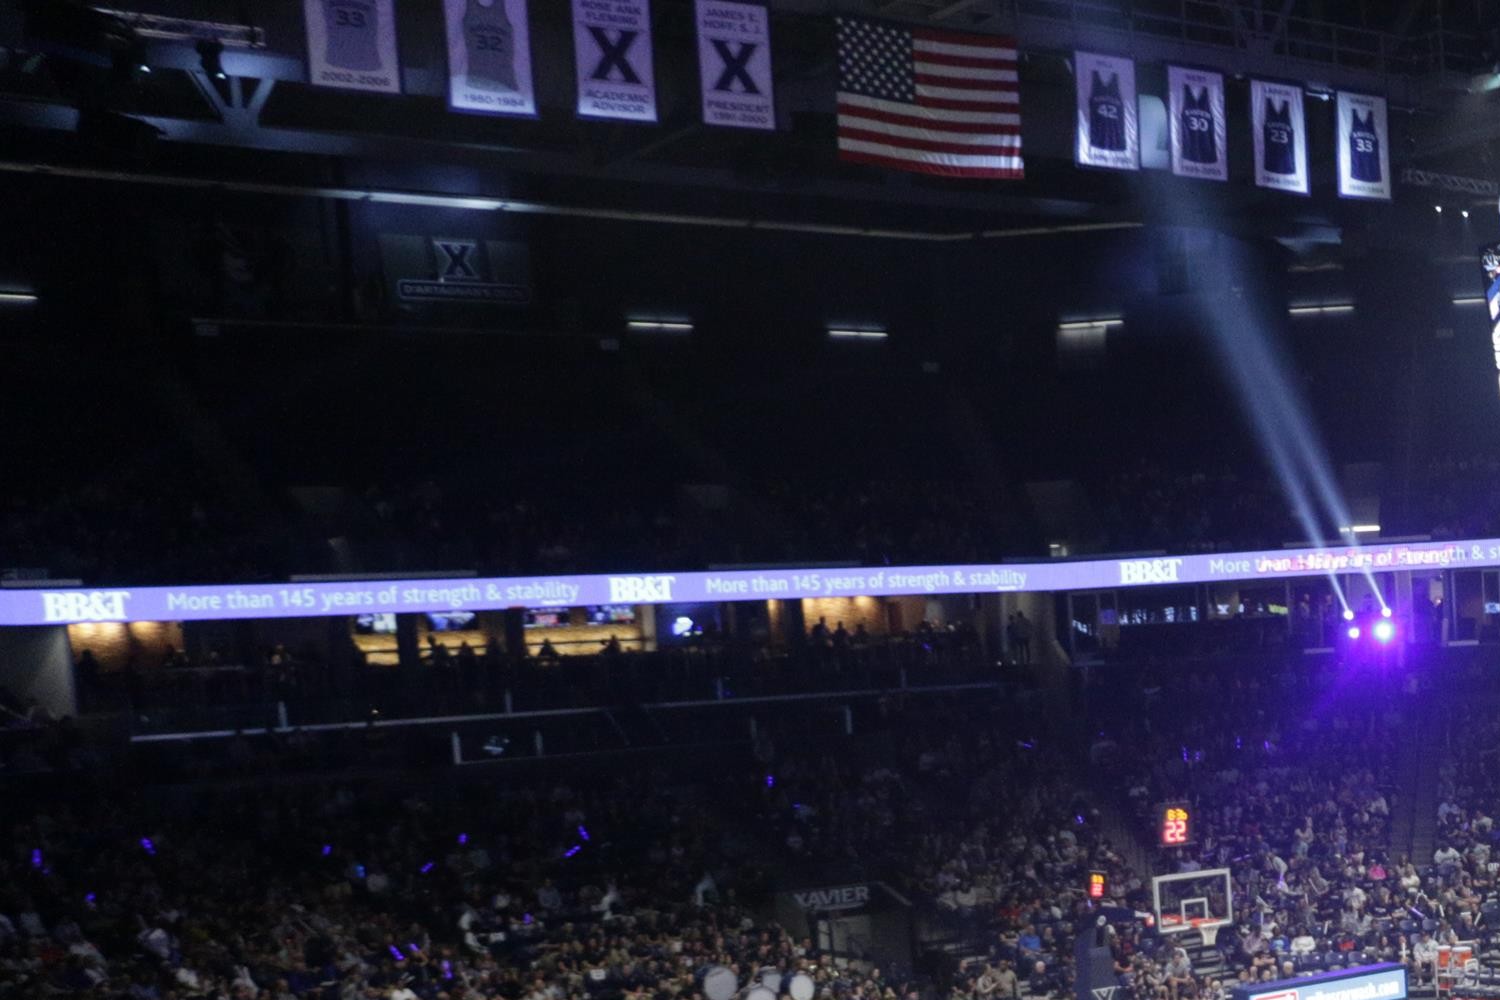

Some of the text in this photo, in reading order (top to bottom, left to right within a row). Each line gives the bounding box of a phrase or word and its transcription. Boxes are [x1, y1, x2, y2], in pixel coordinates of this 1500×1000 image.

[336, 9, 366, 28] 33
[705, 8, 746, 22] JAMES
[477, 34, 502, 52] 32
[586, 26, 642, 84] X
[711, 39, 761, 94] X
[586, 88, 650, 102] ACADEMIC
[592, 101, 646, 114] ADVISOR
[707, 100, 770, 114] PRESIDENT
[1189, 116, 1209, 132] 30
[1270, 130, 1289, 144] 23
[1356, 139, 1374, 153] 33
[431, 239, 479, 279] X
[1209, 557, 1252, 574] More
[1471, 544, 1485, 560] &
[706, 568, 1027, 595] More than 145 years of strength & stability
[1120, 558, 1182, 584] BB&T
[166, 581, 580, 613] More than 145 years of strength & stability
[609, 576, 676, 602] BB&T
[42, 592, 129, 622] BB&T
[1164, 820, 1186, 842] 22
[793, 886, 872, 907] XAVIER
